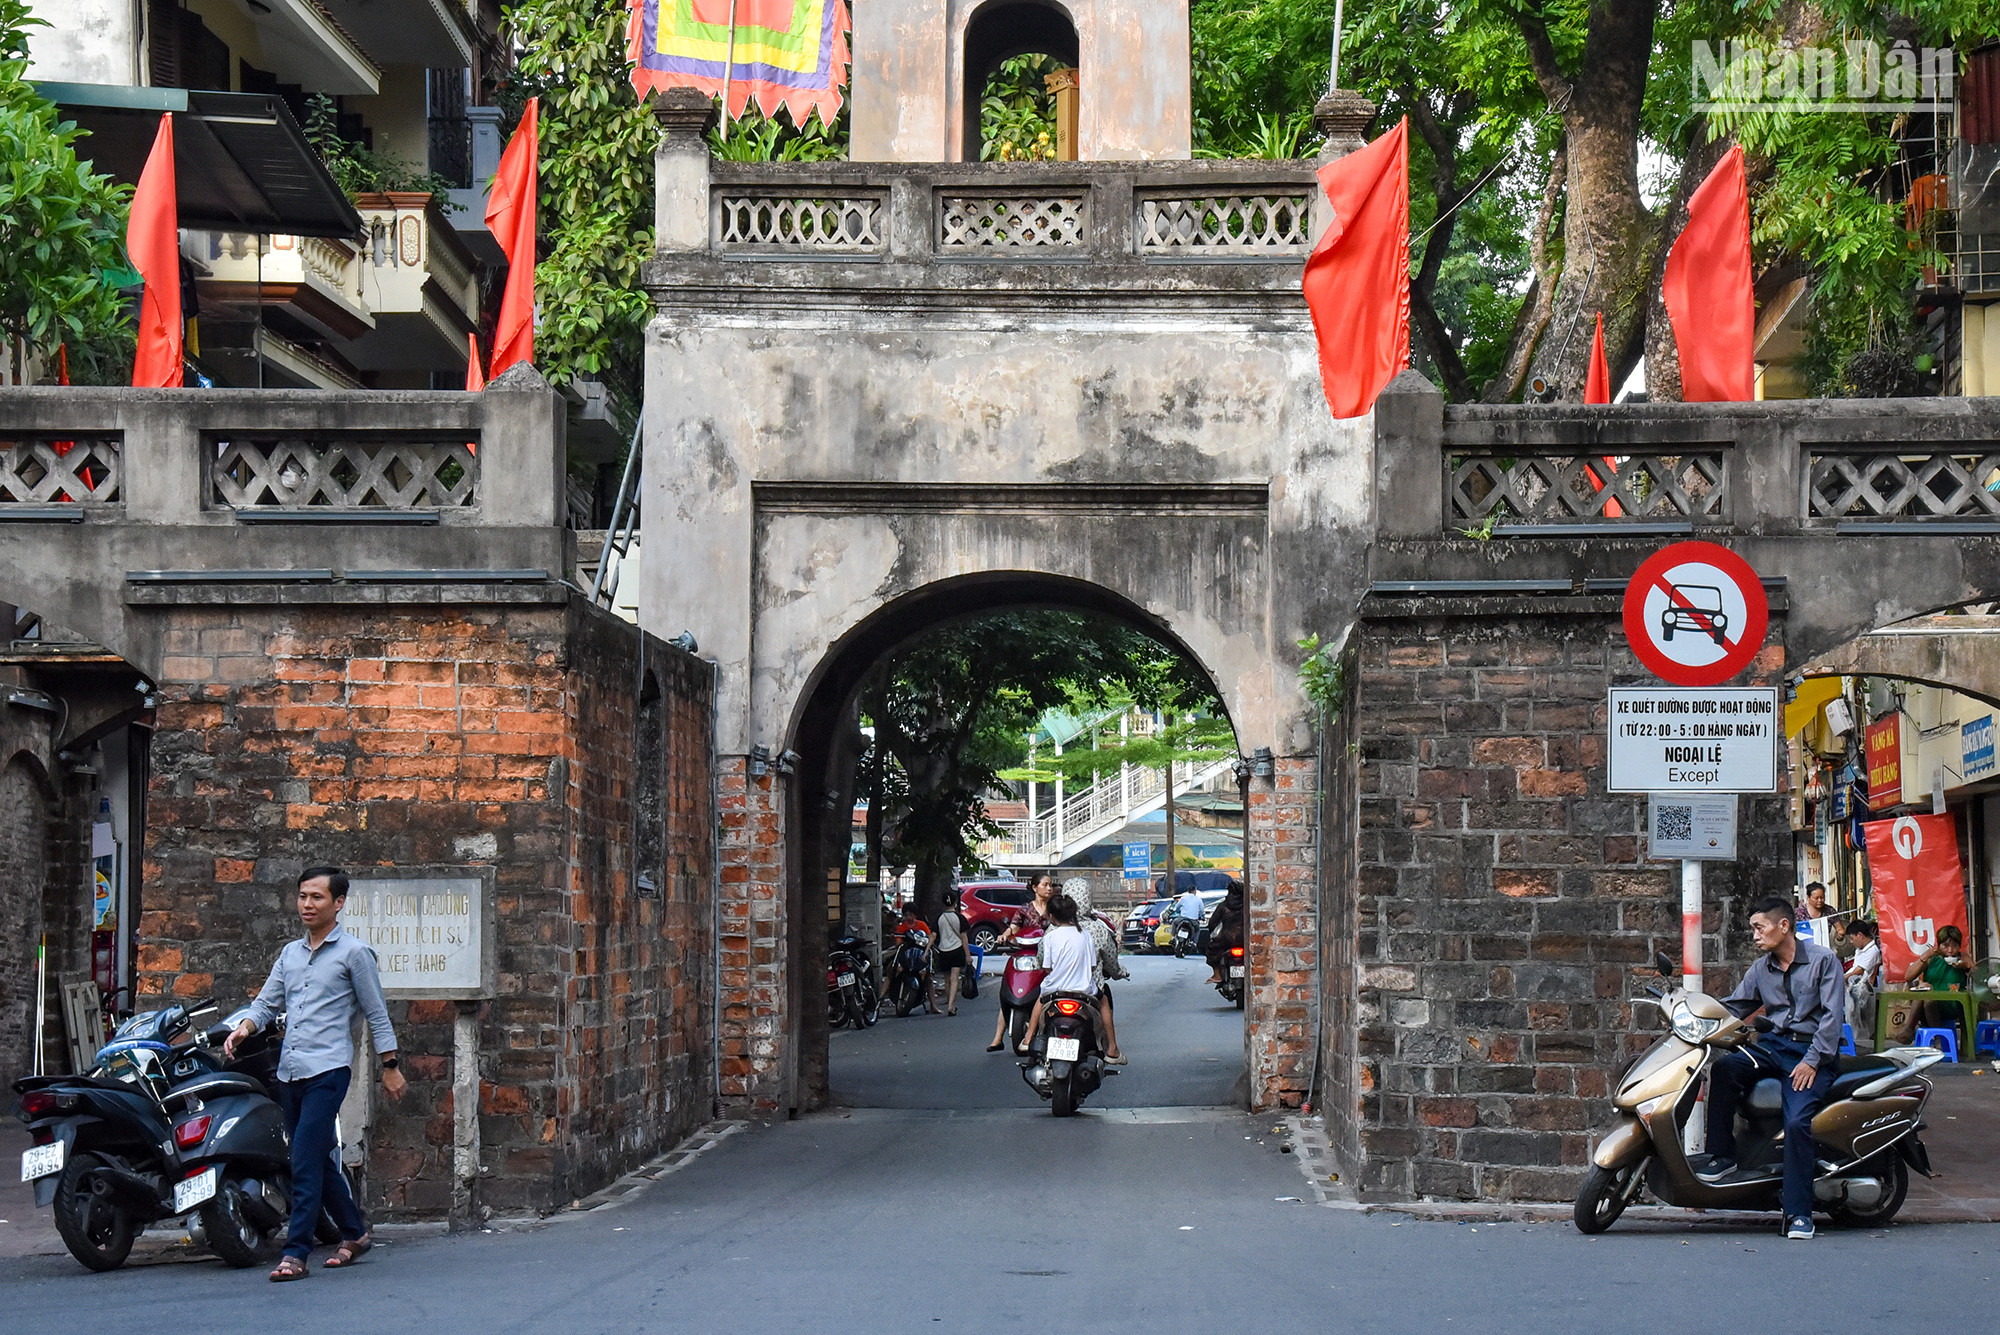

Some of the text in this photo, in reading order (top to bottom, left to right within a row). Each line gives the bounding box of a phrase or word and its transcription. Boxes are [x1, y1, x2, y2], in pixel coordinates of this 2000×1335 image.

[1617, 697, 1772, 717] XE QUÉT ĐƯỜNG ĐƯỢC HOẠT ĐỘNG
[1707, 720, 1733, 737] HÀNG
[1665, 743, 1722, 765] NGOẠI LỆ
[1669, 768, 1719, 785] Except
[385, 893, 418, 917] QUAN
